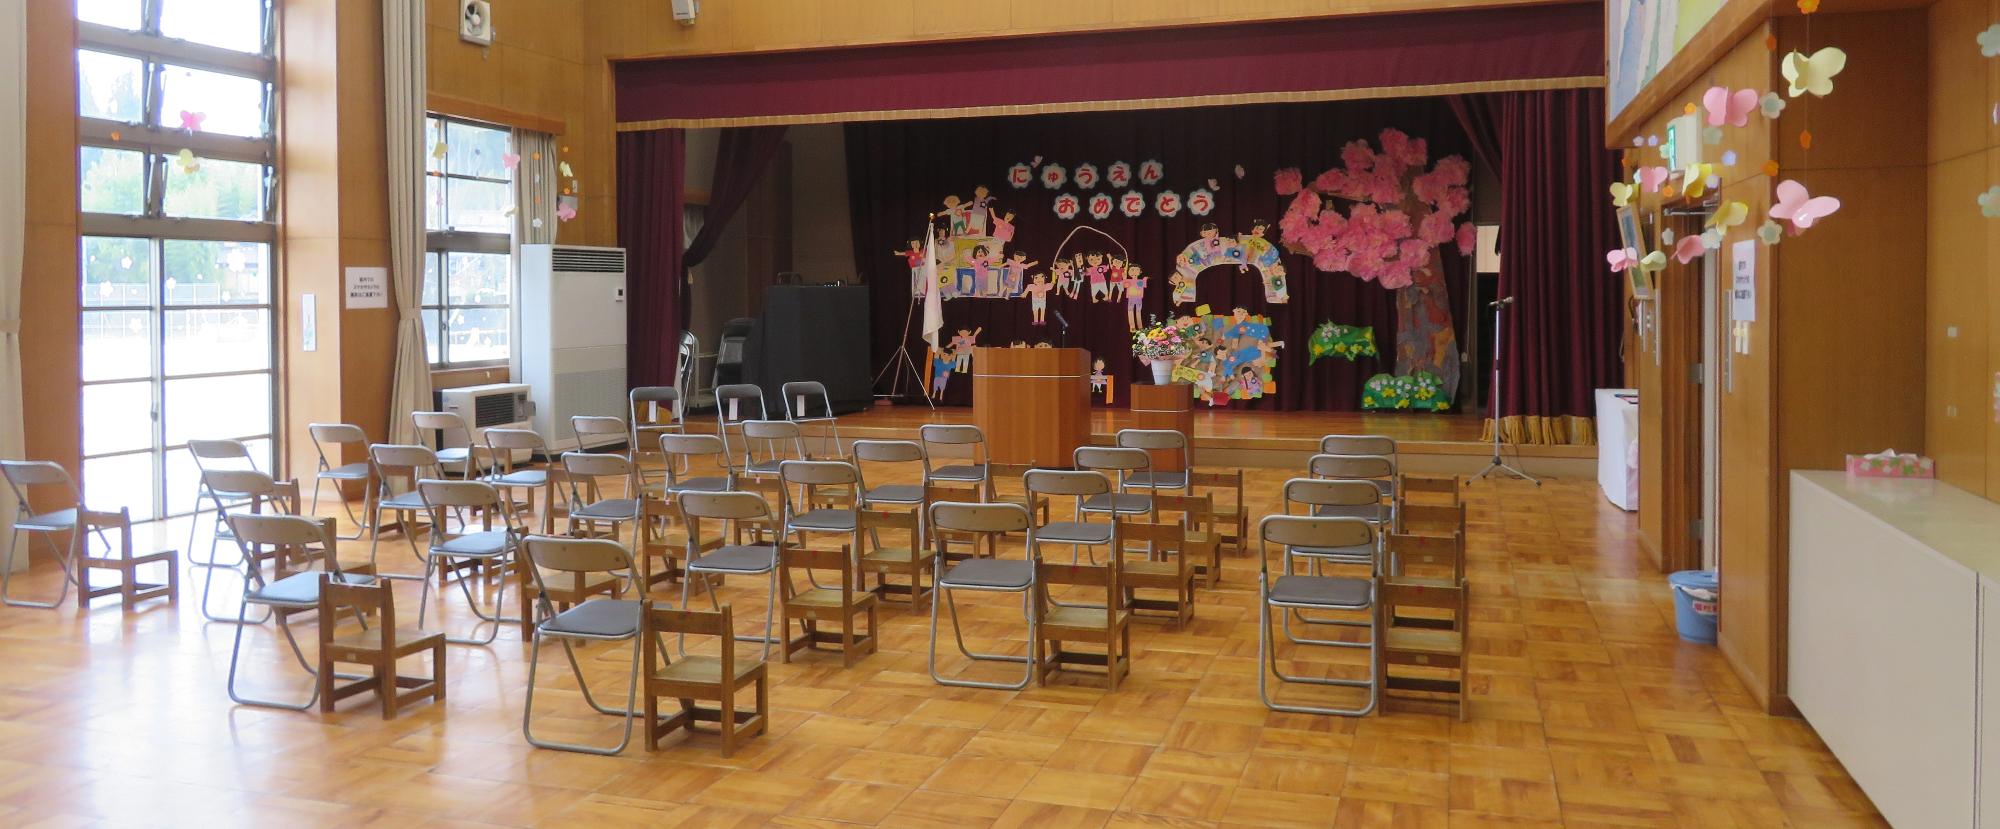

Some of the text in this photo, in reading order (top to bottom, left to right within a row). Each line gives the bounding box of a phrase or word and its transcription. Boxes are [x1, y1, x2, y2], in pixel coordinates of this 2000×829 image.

[1010, 163, 1160, 185] にゅうえん
[1056, 194, 1211, 215] おめでとう
